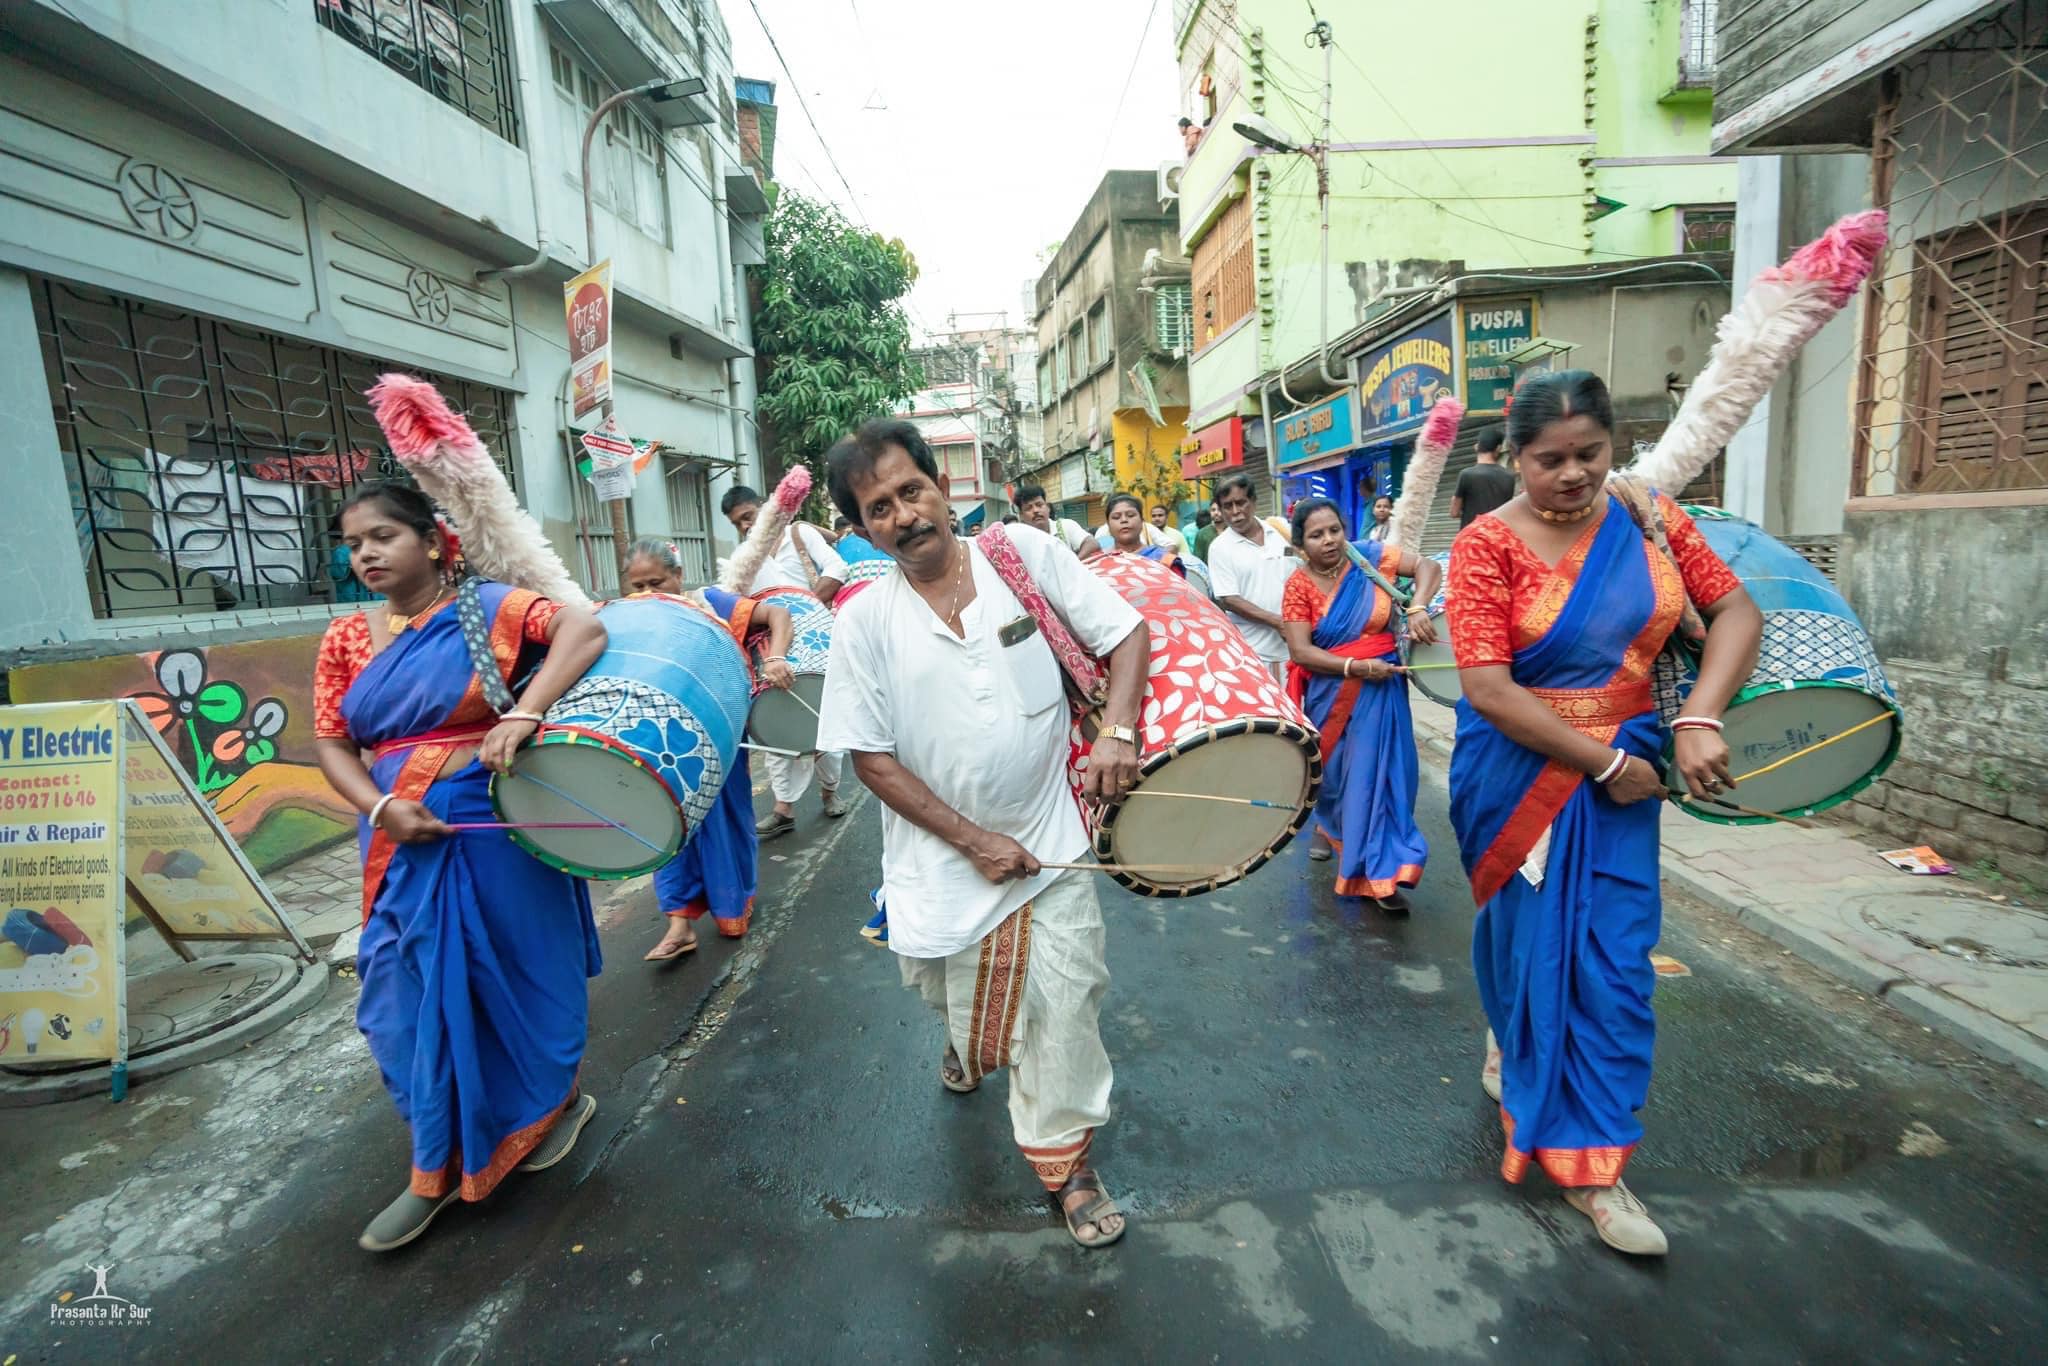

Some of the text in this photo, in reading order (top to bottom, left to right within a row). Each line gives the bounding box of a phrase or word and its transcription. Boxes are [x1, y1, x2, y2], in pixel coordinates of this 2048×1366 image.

[1470, 309, 1525, 331] PUSPA
[1361, 338, 1451, 408] PUSPA JEWELLERS
[1286, 419, 1308, 442] BLUE
[22, 724, 113, 759] Electric
[0, 790, 96, 810] 89271646
[0, 823, 105, 844] ir & Repair
[2, 859, 13, 877] All
[16, 857, 37, 877] kinds
[40, 856, 48, 876] of
[50, 855, 85, 877] Electrical
[16, 882, 21, 902] &
[23, 881, 52, 901] electrical
[53, 879, 80, 905] repairing
[81, 880, 105, 899] services
